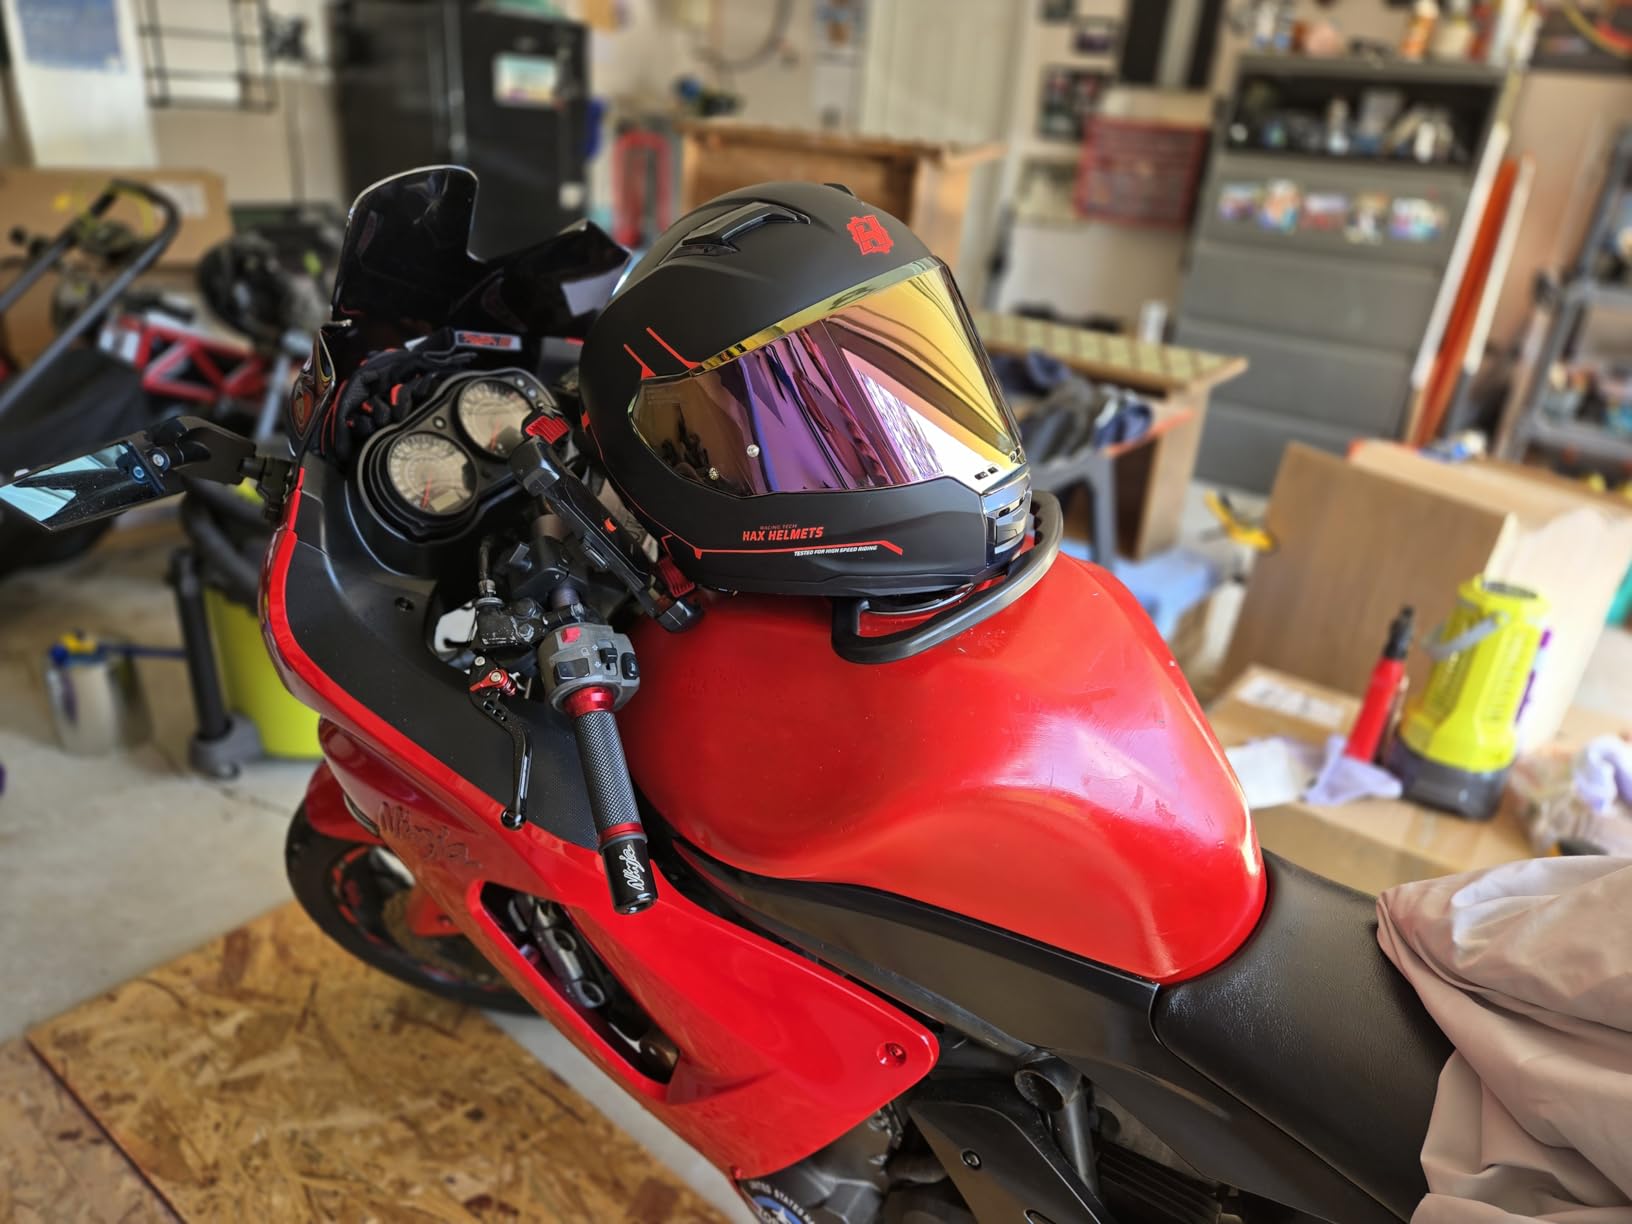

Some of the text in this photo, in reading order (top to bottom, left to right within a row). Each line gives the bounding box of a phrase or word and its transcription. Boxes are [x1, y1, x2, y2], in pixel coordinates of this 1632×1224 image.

[742, 526, 825, 542] HAX HELMETS
[377, 801, 482, 868] Ninja
[619, 844, 645, 891] Ninja
[773, 1188, 805, 1216] STATES
